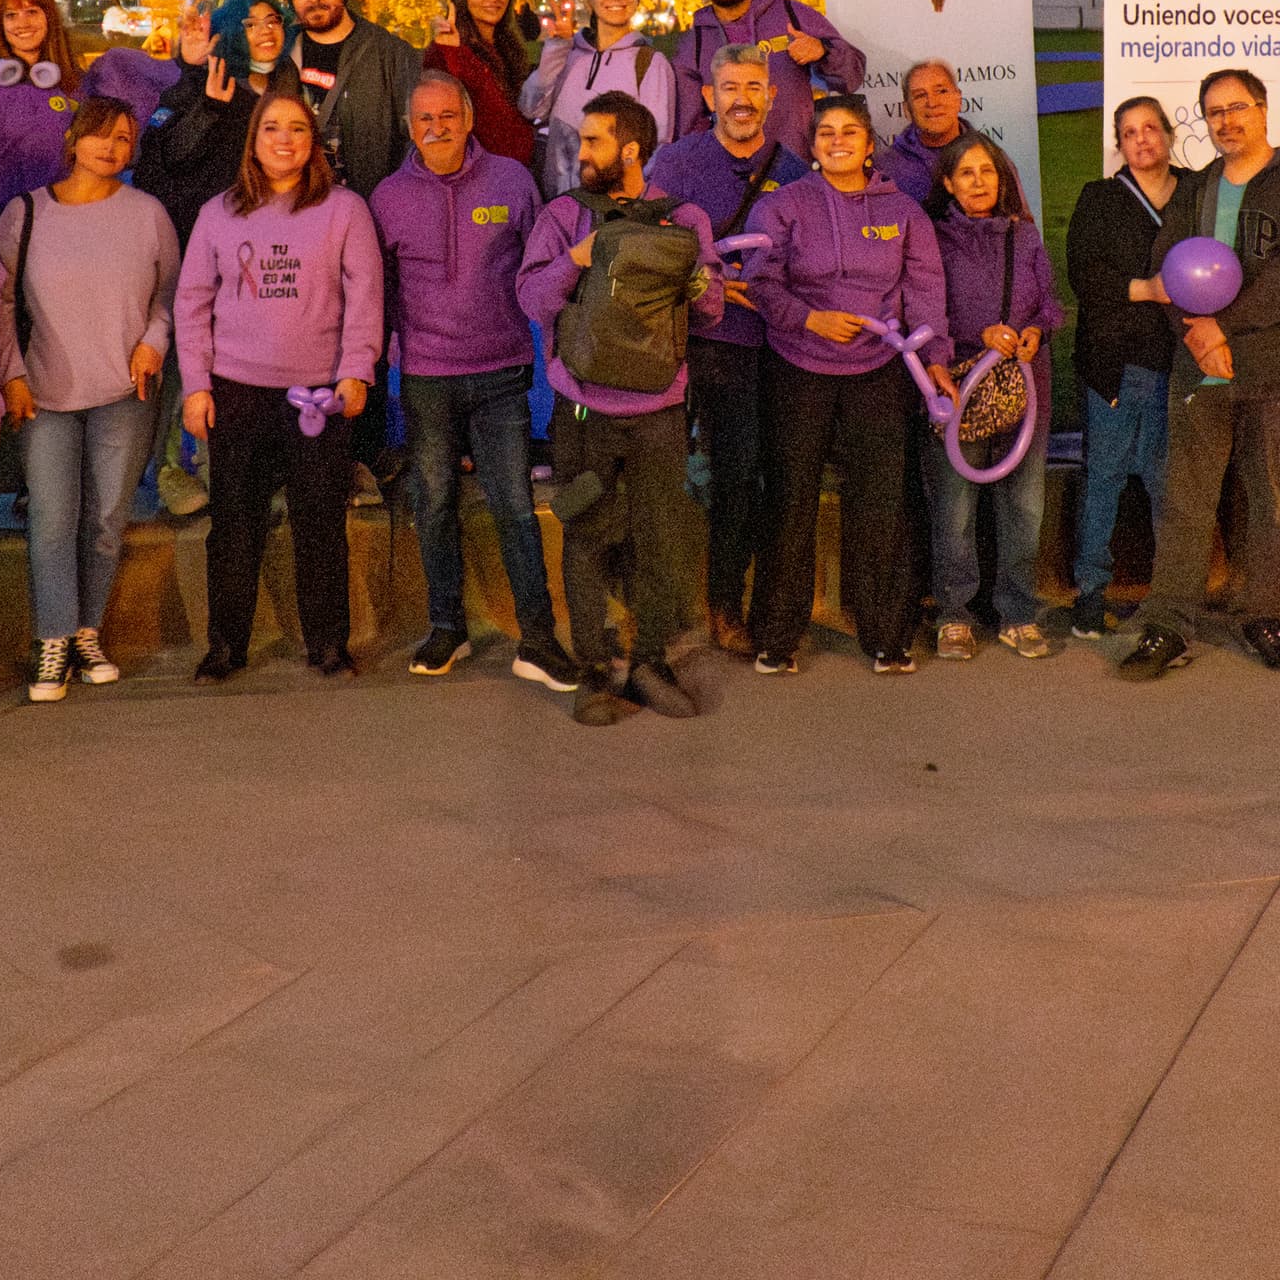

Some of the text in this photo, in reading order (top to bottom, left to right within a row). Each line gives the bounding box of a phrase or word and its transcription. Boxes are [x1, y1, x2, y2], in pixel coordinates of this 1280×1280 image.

[1123, 3, 1216, 26] Uniendo
[1121, 34, 1236, 63] mejorando
[271, 244, 288, 256] TU
[260, 259, 301, 270] LUCHA
[281, 273, 296, 284] MI
[259, 287, 299, 299] LUCHA
